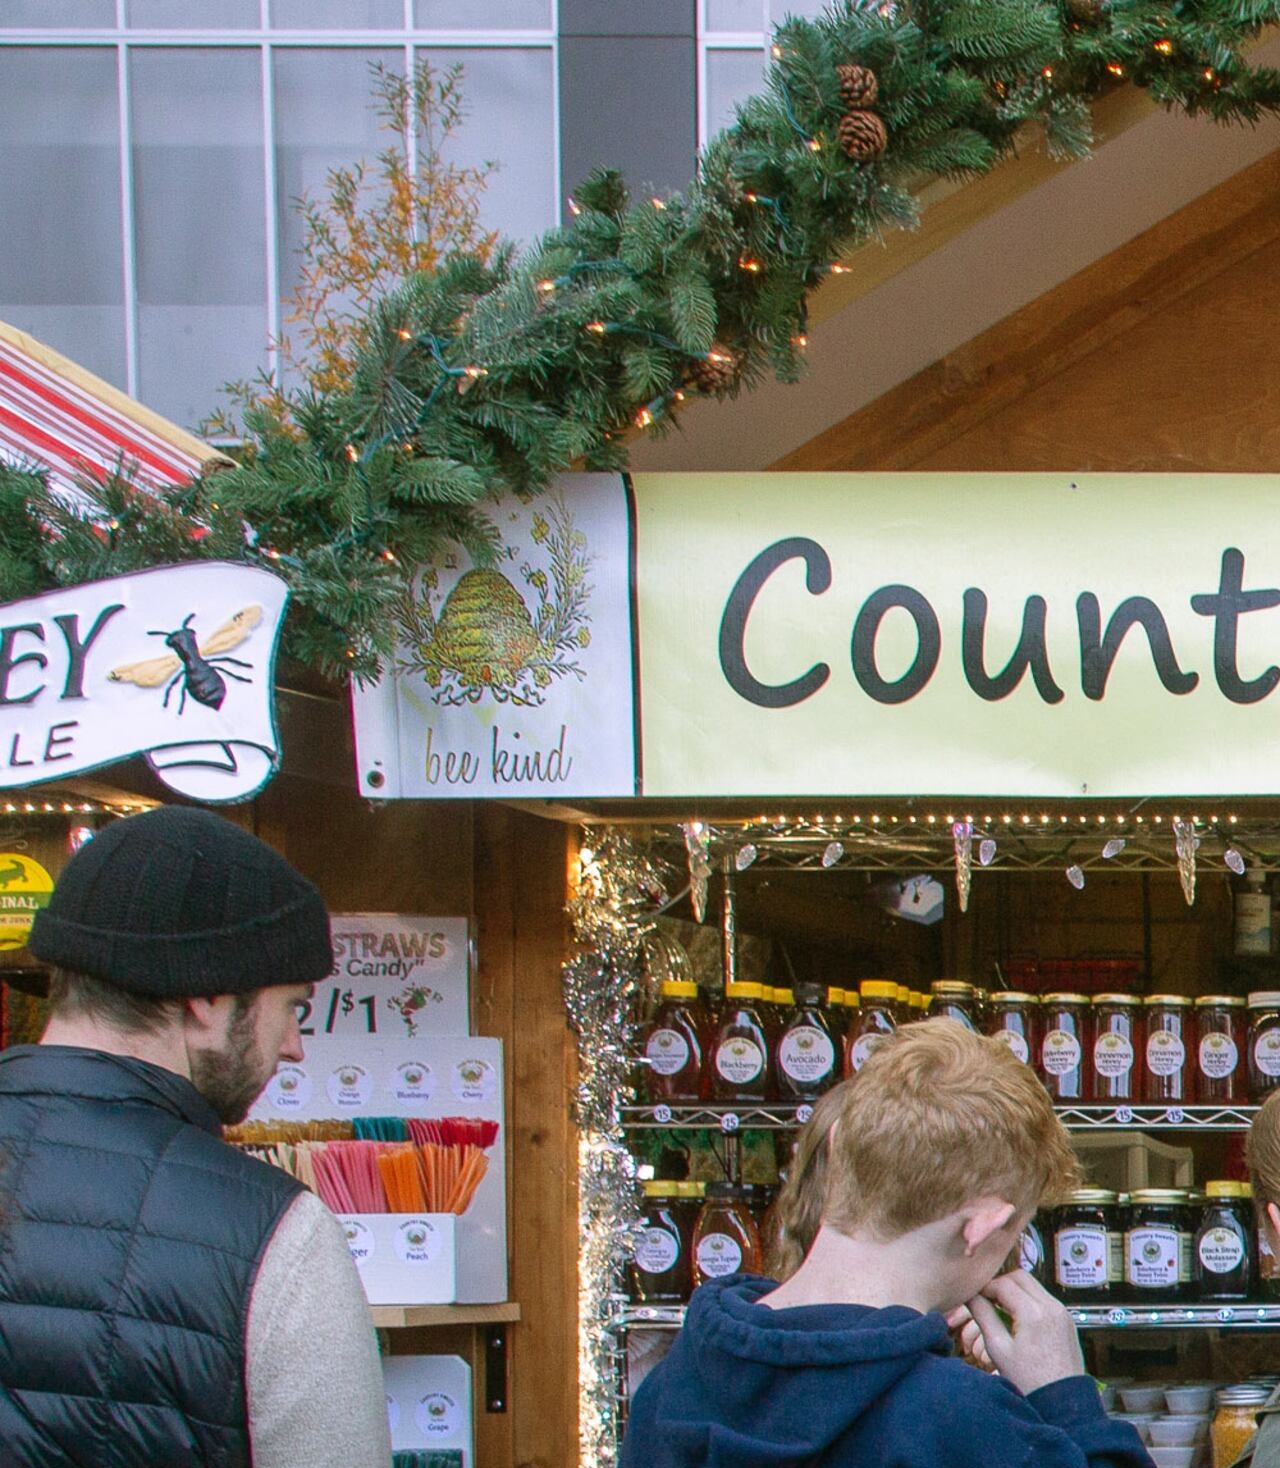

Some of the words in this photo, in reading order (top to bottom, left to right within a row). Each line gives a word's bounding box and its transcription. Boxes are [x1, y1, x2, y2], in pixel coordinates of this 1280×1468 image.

[425, 727, 479, 785] bee
[492, 724, 573, 784] kind
[333, 932, 447, 958] STRAWS
[785, 1053, 826, 1064] Avocado
[720, 1059, 758, 1070] Blackberry
[406, 1252, 428, 1261] Peach
